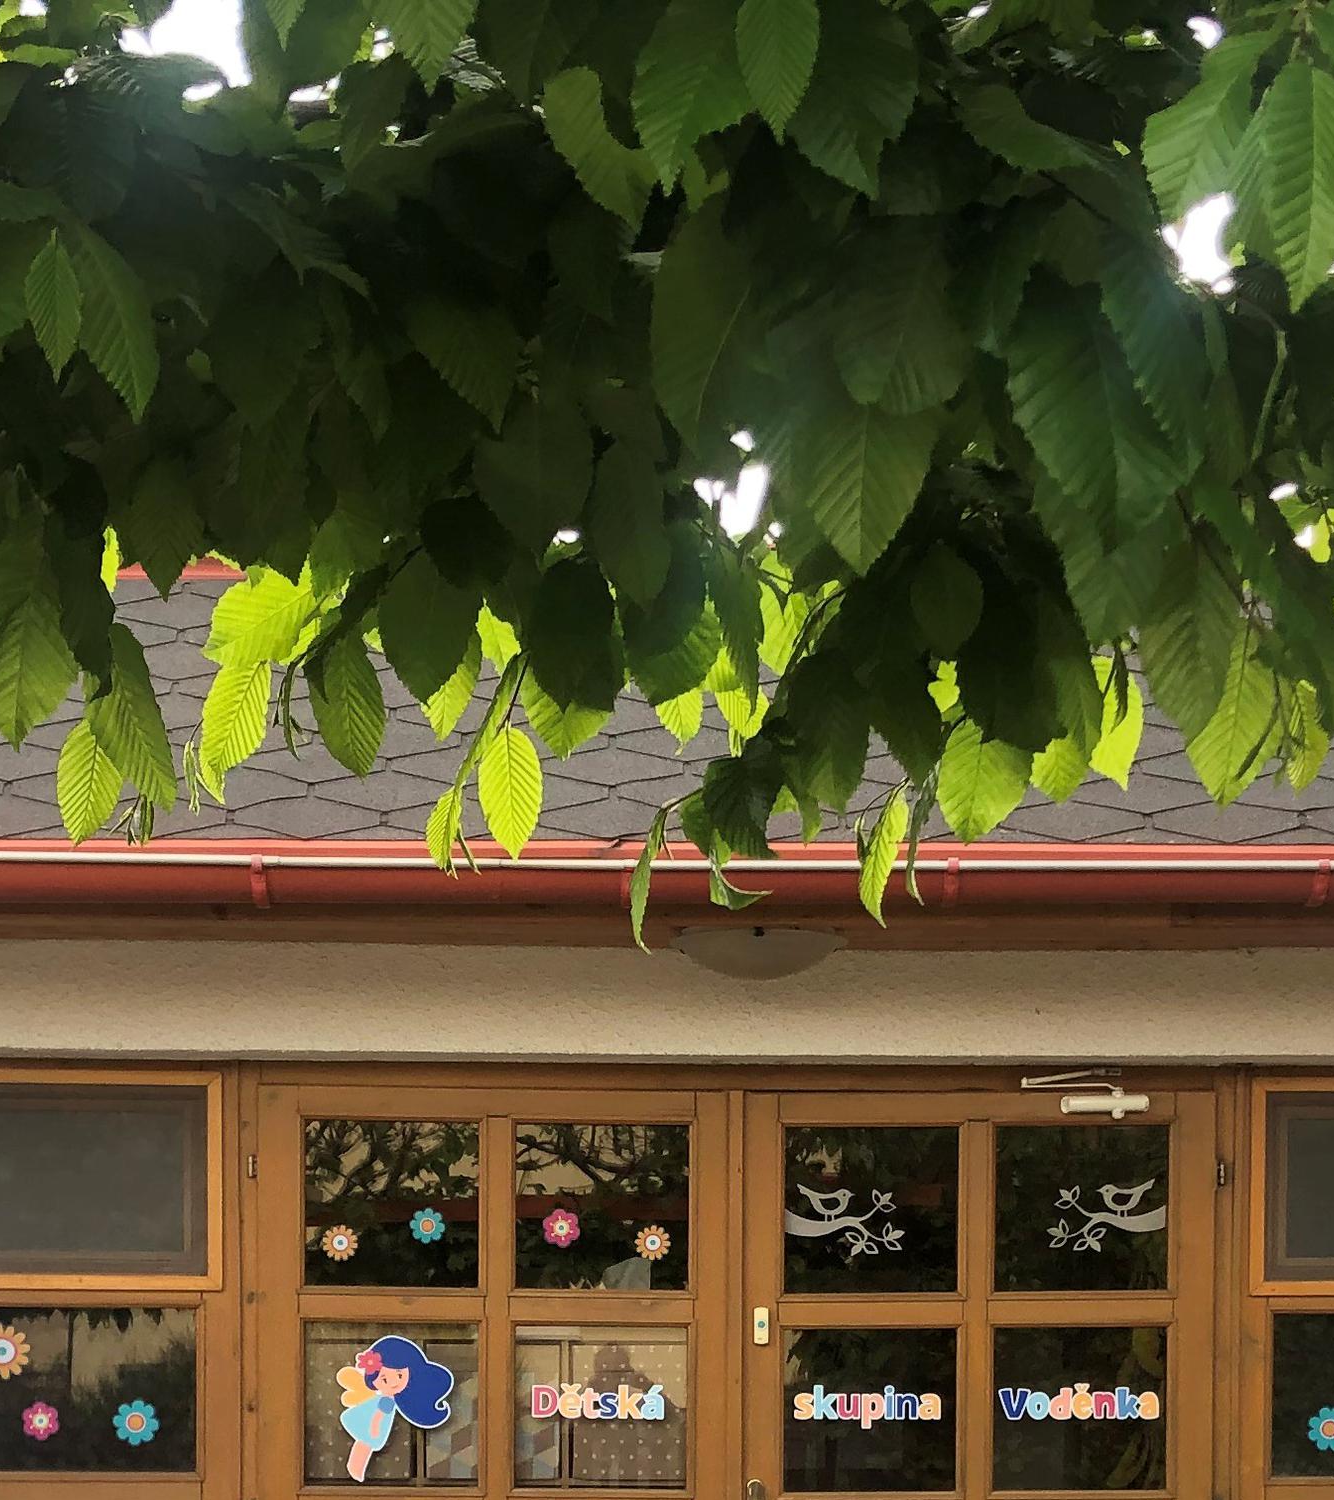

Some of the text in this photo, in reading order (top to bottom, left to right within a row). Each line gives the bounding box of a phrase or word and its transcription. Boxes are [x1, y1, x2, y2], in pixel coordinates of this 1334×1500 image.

[530, 1383, 1161, 1430] Dětská skupina Voděnka
